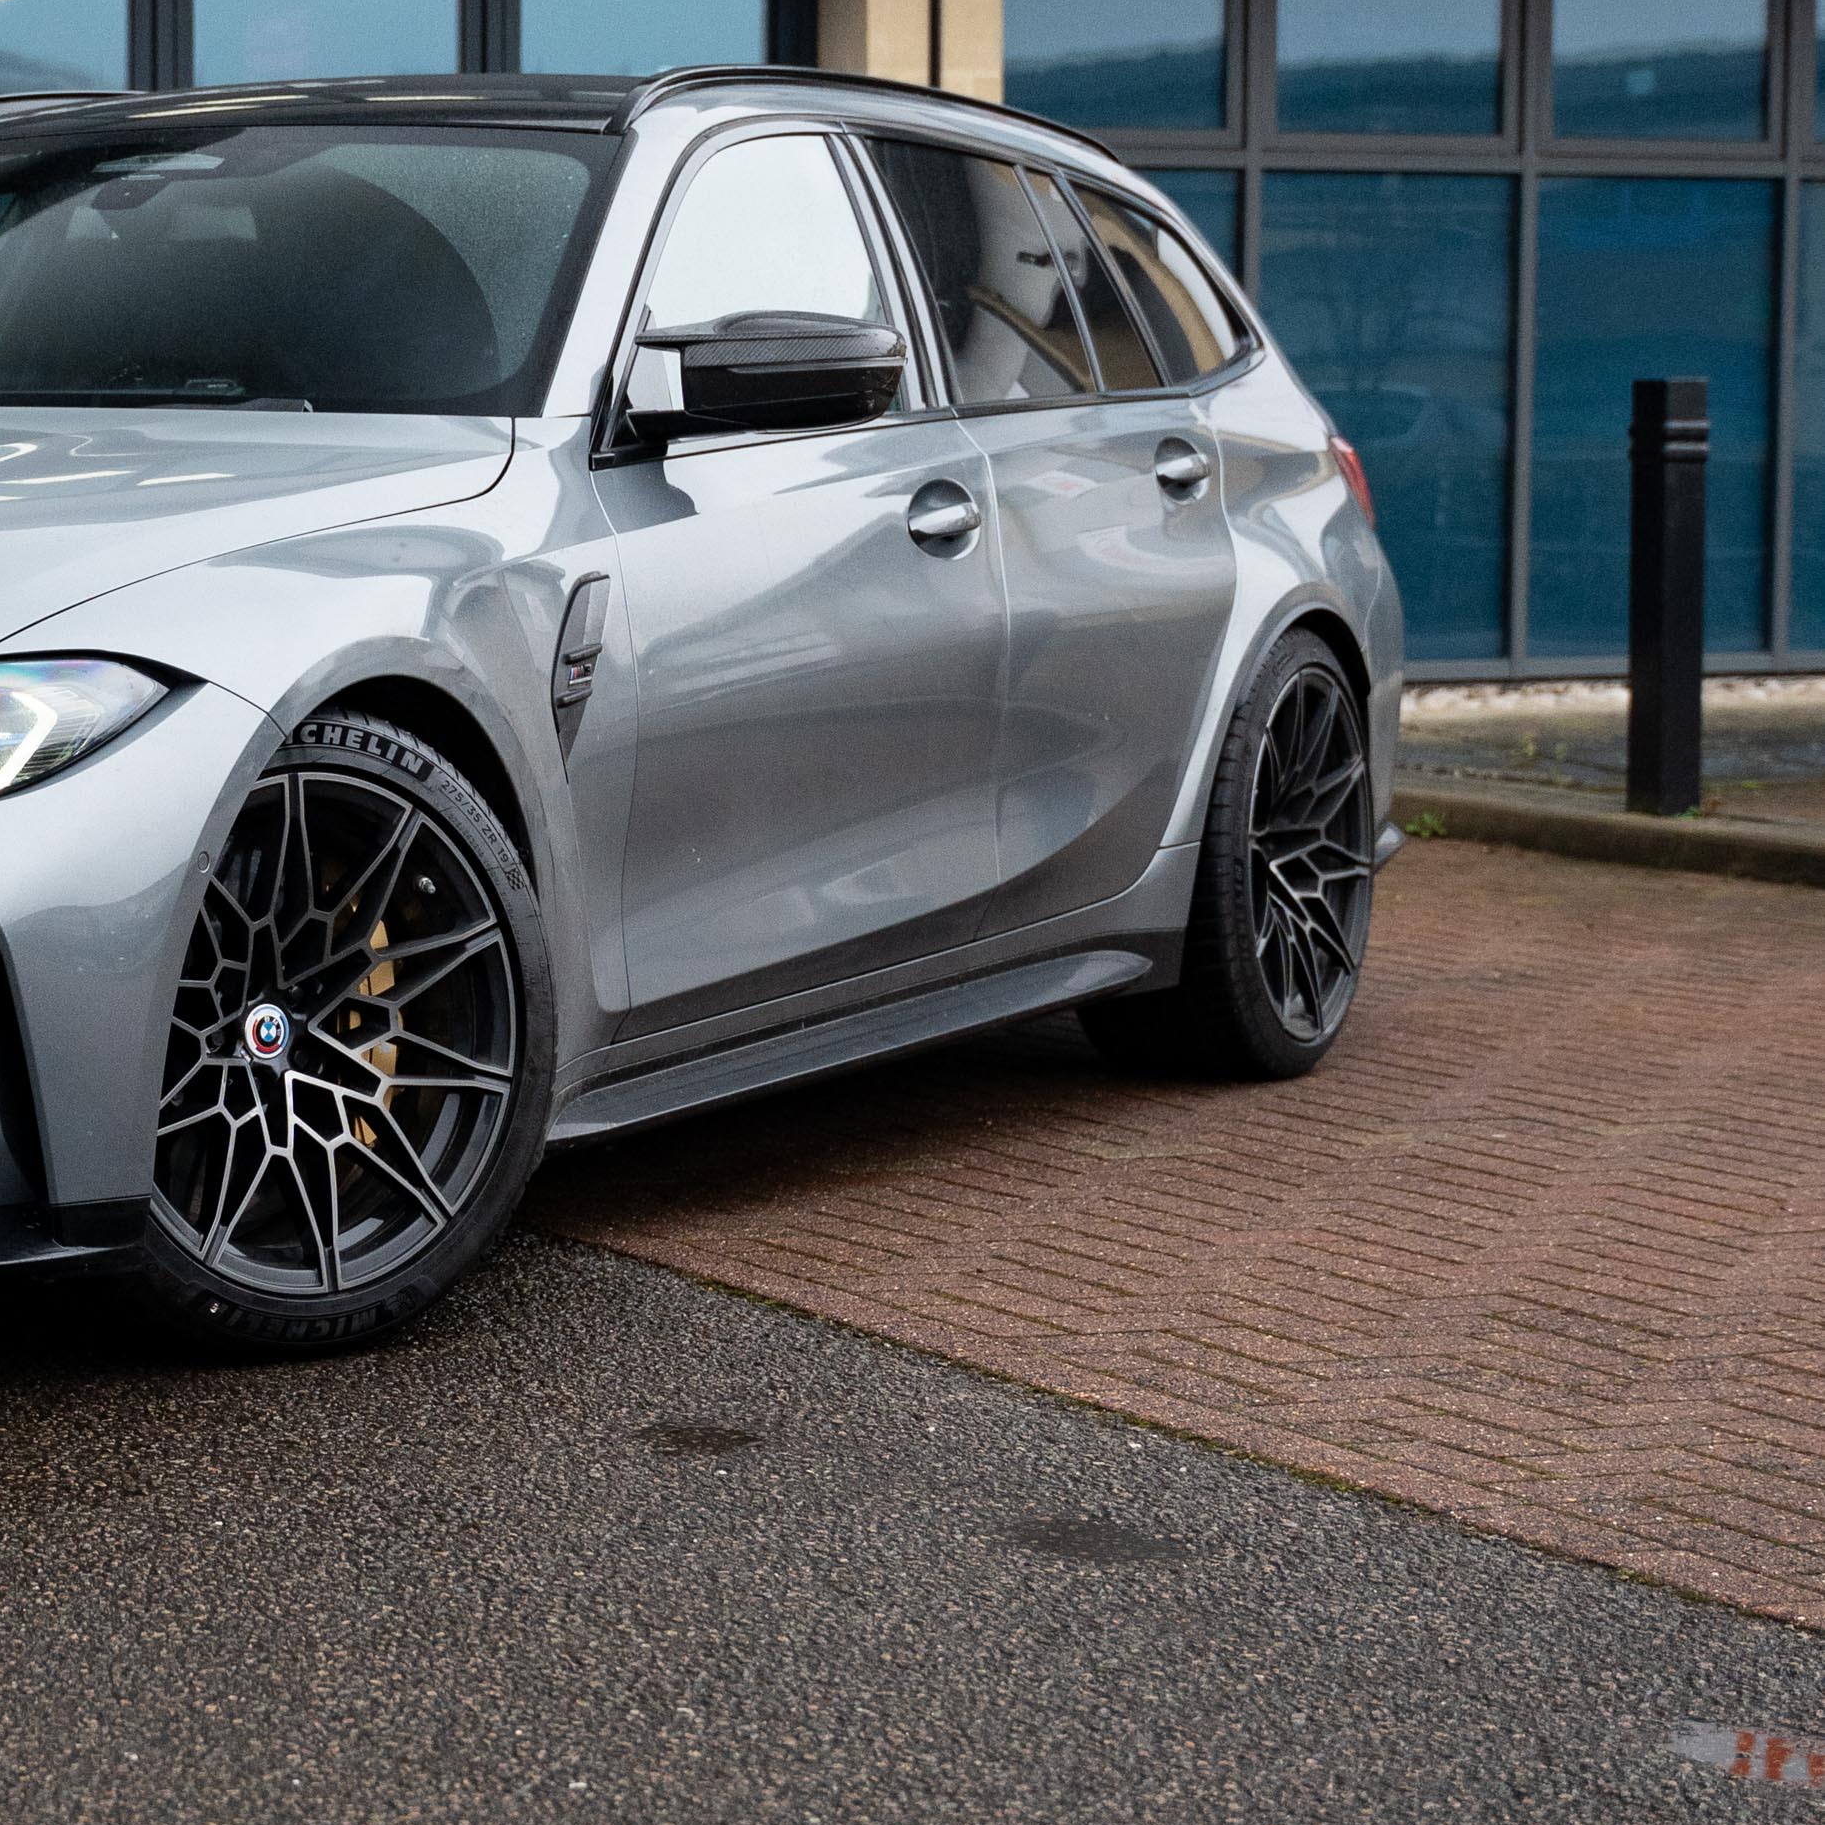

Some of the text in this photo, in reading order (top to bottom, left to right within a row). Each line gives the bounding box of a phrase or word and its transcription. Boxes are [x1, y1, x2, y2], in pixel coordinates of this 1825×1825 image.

[440, 779, 482, 823] 275/35
[481, 824, 497, 845] ZR
[497, 847, 510, 864] 19
